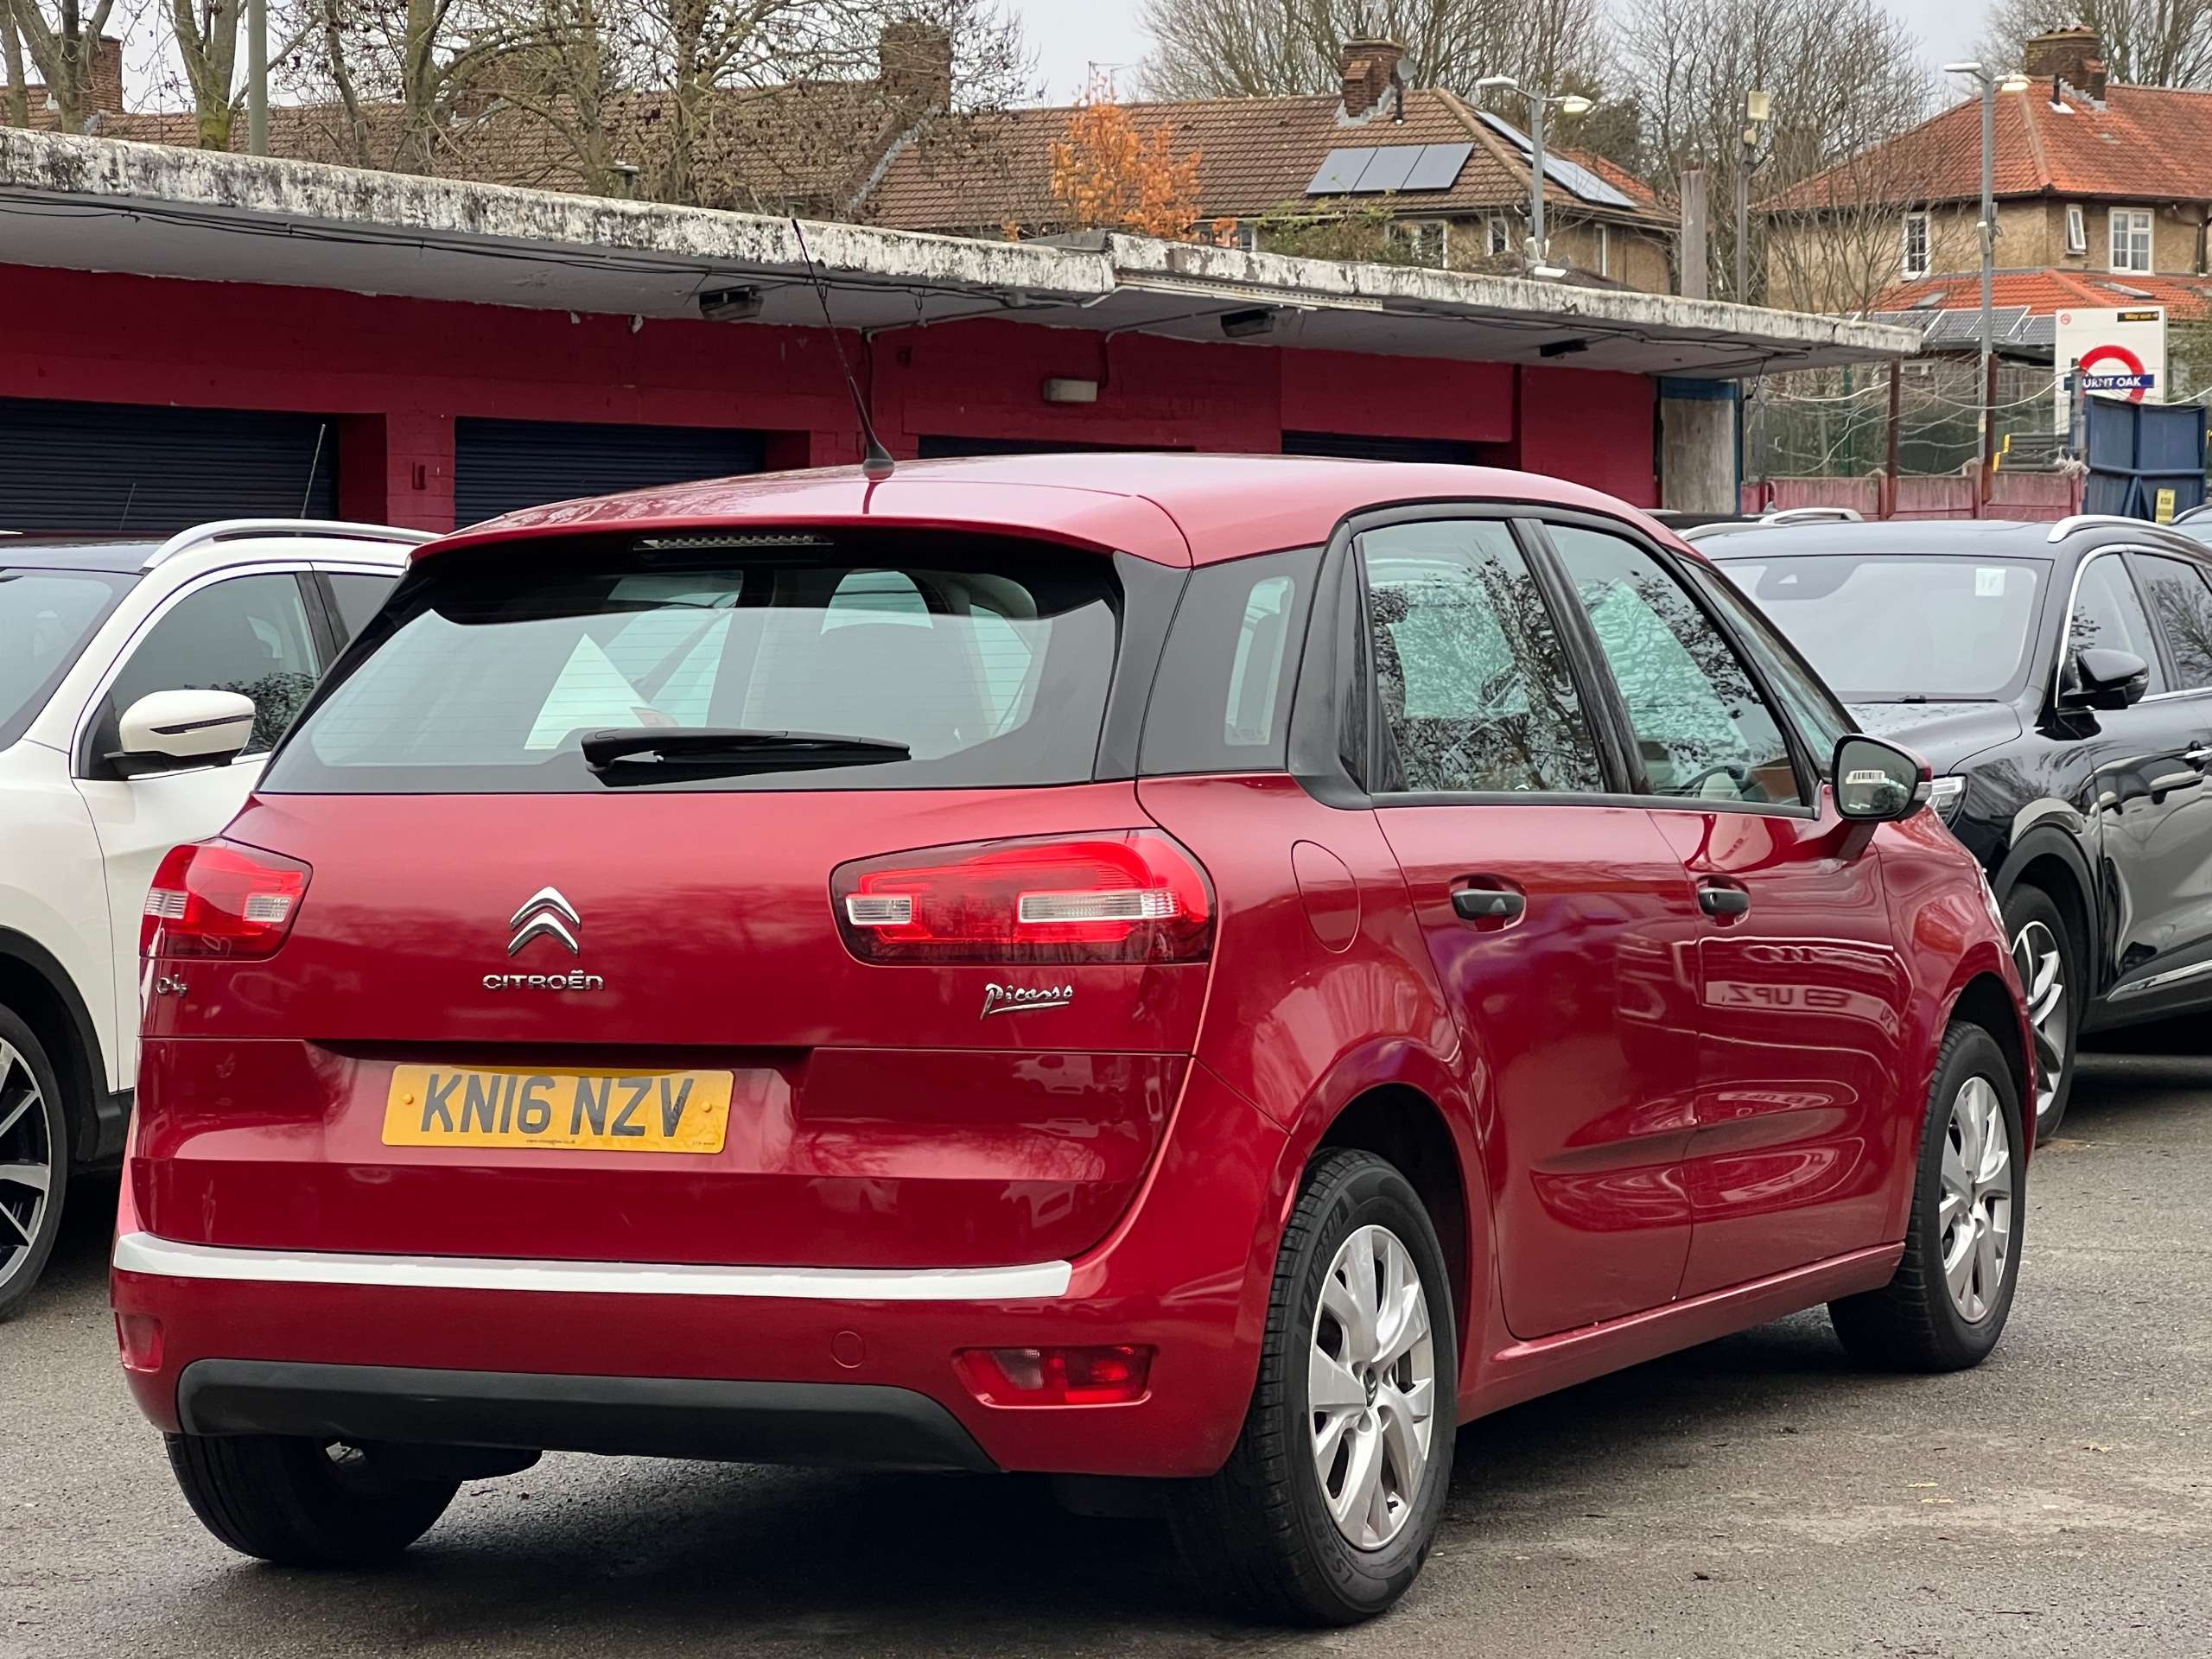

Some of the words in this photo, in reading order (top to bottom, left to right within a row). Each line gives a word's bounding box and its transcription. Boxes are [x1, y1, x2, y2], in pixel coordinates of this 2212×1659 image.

[2082, 377, 2114, 388] URNT
[2116, 376, 2141, 387] OAK
[482, 969, 604, 989] CITROËN
[979, 982, 1074, 1020] Picasso
[420, 1073, 556, 1135] KN16
[569, 1076, 695, 1138] NZV
